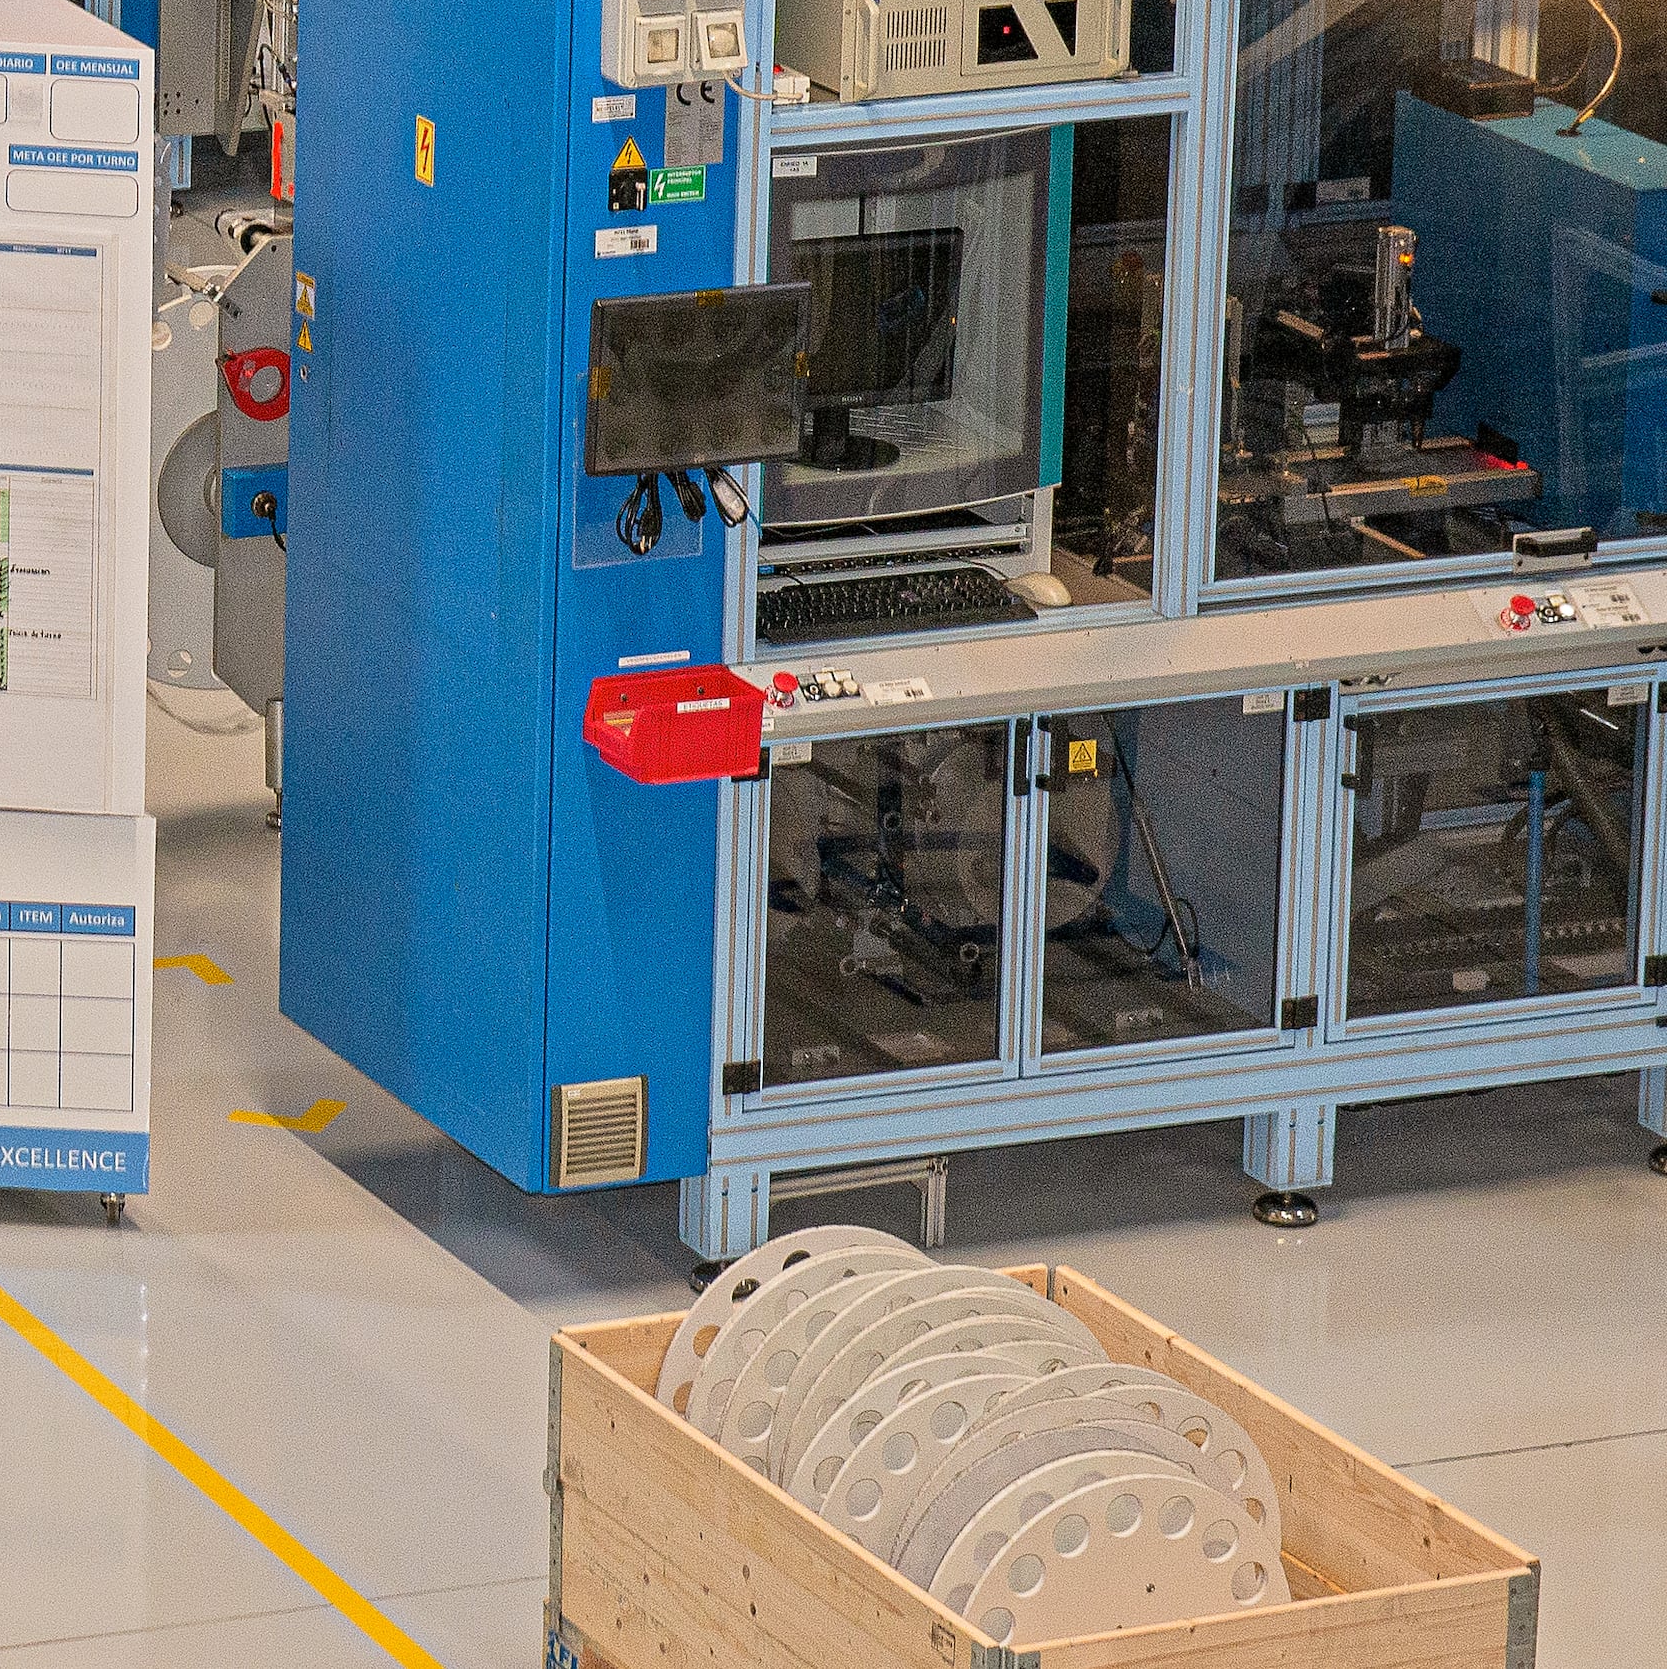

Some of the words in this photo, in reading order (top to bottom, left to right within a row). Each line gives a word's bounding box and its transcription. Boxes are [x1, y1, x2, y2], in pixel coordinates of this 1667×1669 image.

[55, 60, 77, 71] OEE
[80, 61, 134, 74] MENSUAL
[13, 150, 44, 162] META
[47, 151, 69, 163] OEE
[71, 153, 94, 165] POR
[97, 155, 136, 167] TURNO
[683, 700, 723, 710] ETIQUETAS
[19, 911, 53, 925] ITEM
[69, 912, 126, 928] Autoriza
